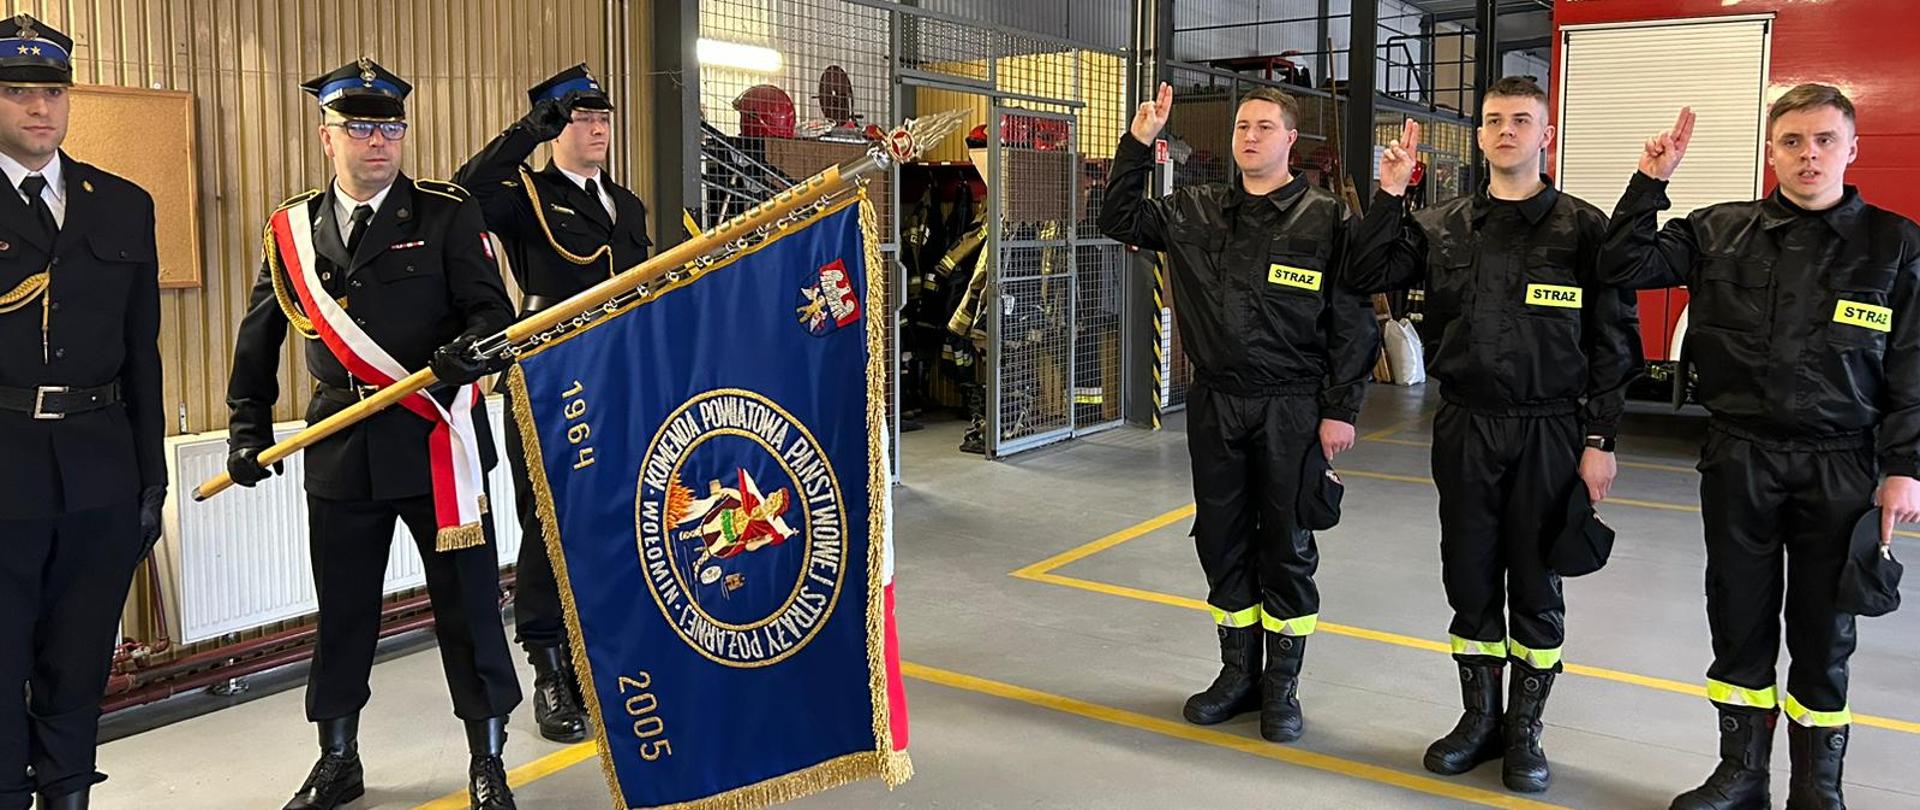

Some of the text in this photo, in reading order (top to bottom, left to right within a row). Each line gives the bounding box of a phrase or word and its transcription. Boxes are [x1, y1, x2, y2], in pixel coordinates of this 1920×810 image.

[561, 380, 596, 470] 1964
[643, 410, 702, 492] KOMENDA
[699, 396, 790, 451] POWIATOWA
[642, 500, 680, 605] WOŁOMIN
[618, 670, 672, 762] 2005
